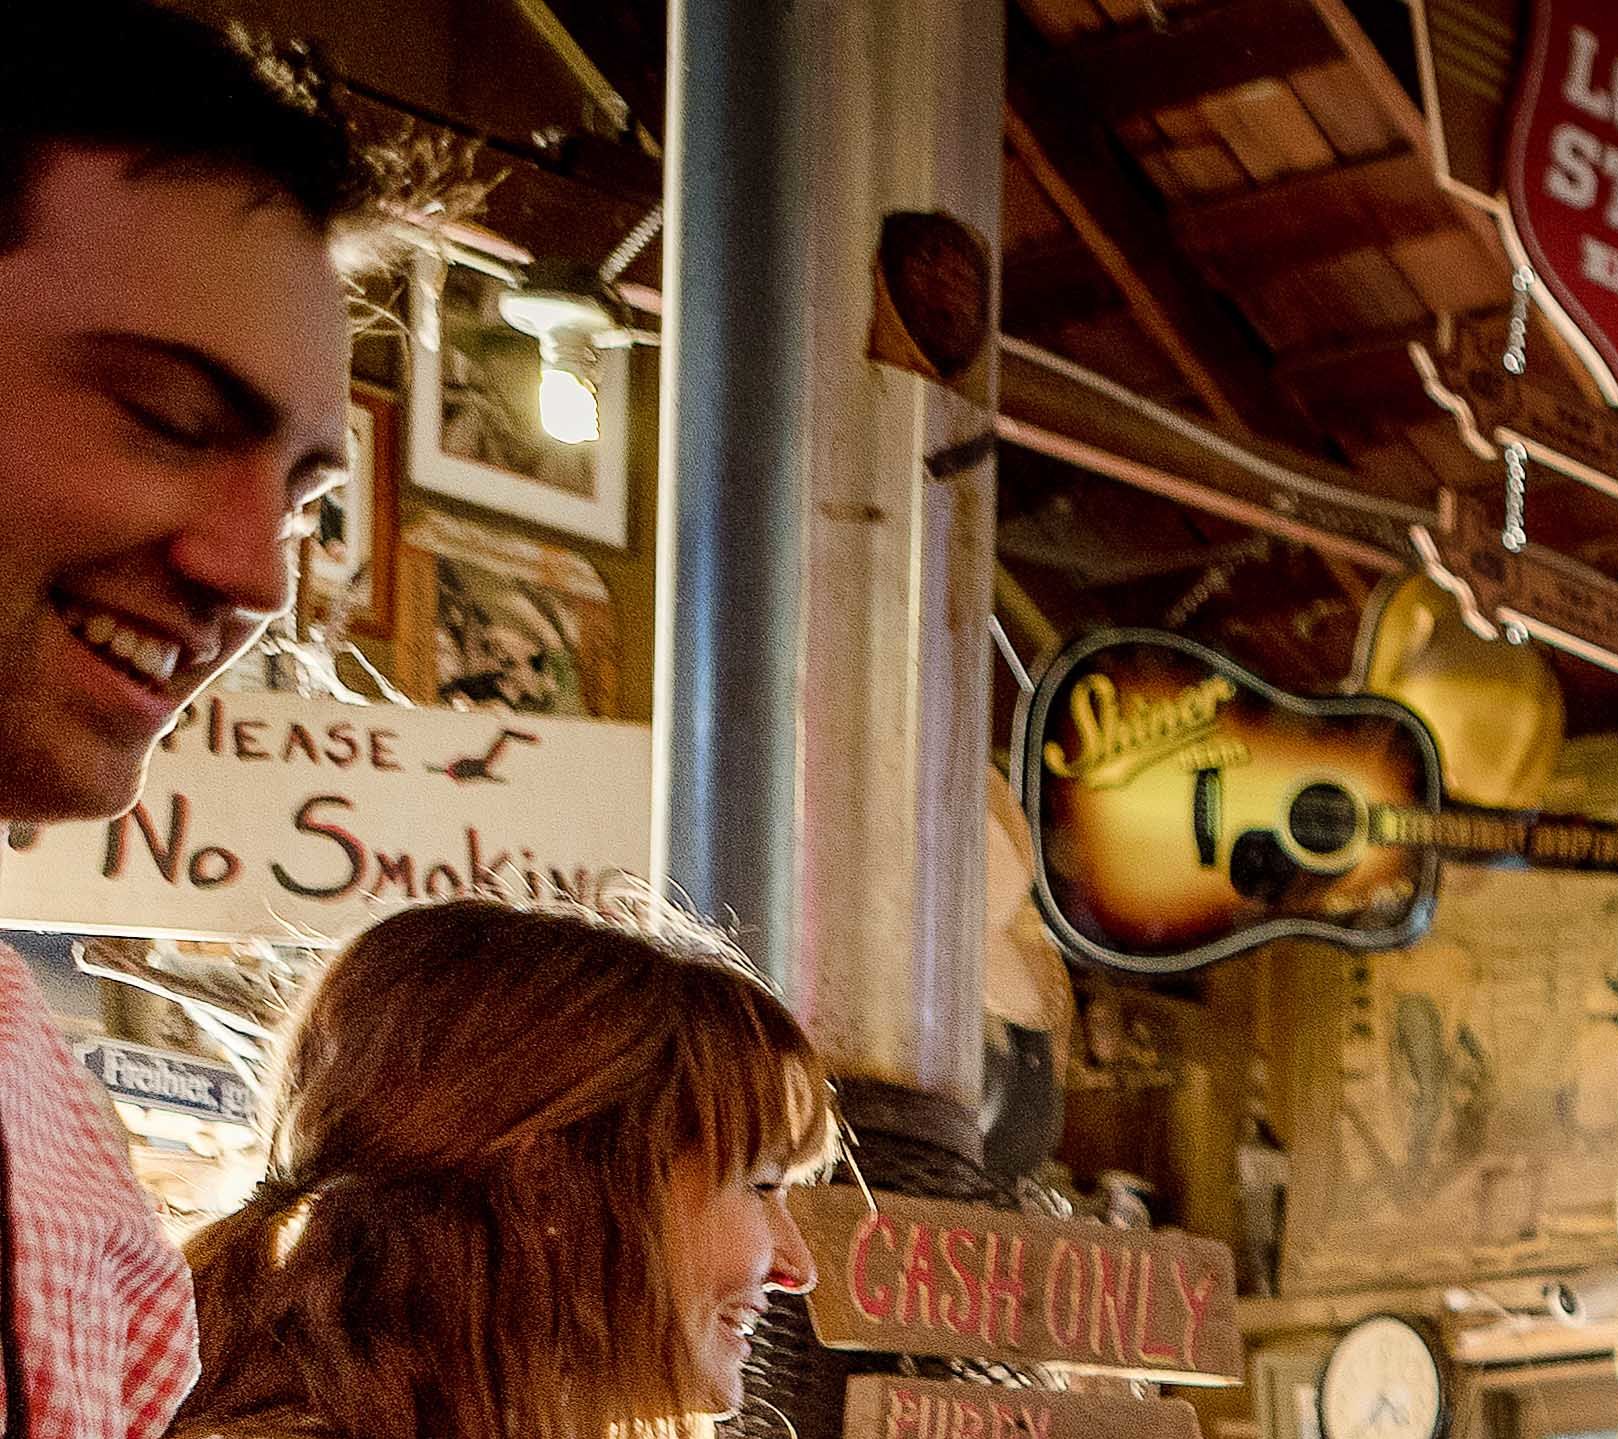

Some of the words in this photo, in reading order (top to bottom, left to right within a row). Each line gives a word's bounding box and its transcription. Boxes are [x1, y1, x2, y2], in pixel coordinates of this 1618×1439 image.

[1043, 672, 1236, 780] Shiner
[850, 1214, 1026, 1348] CASH
[1045, 1238, 1216, 1369] ONLY
